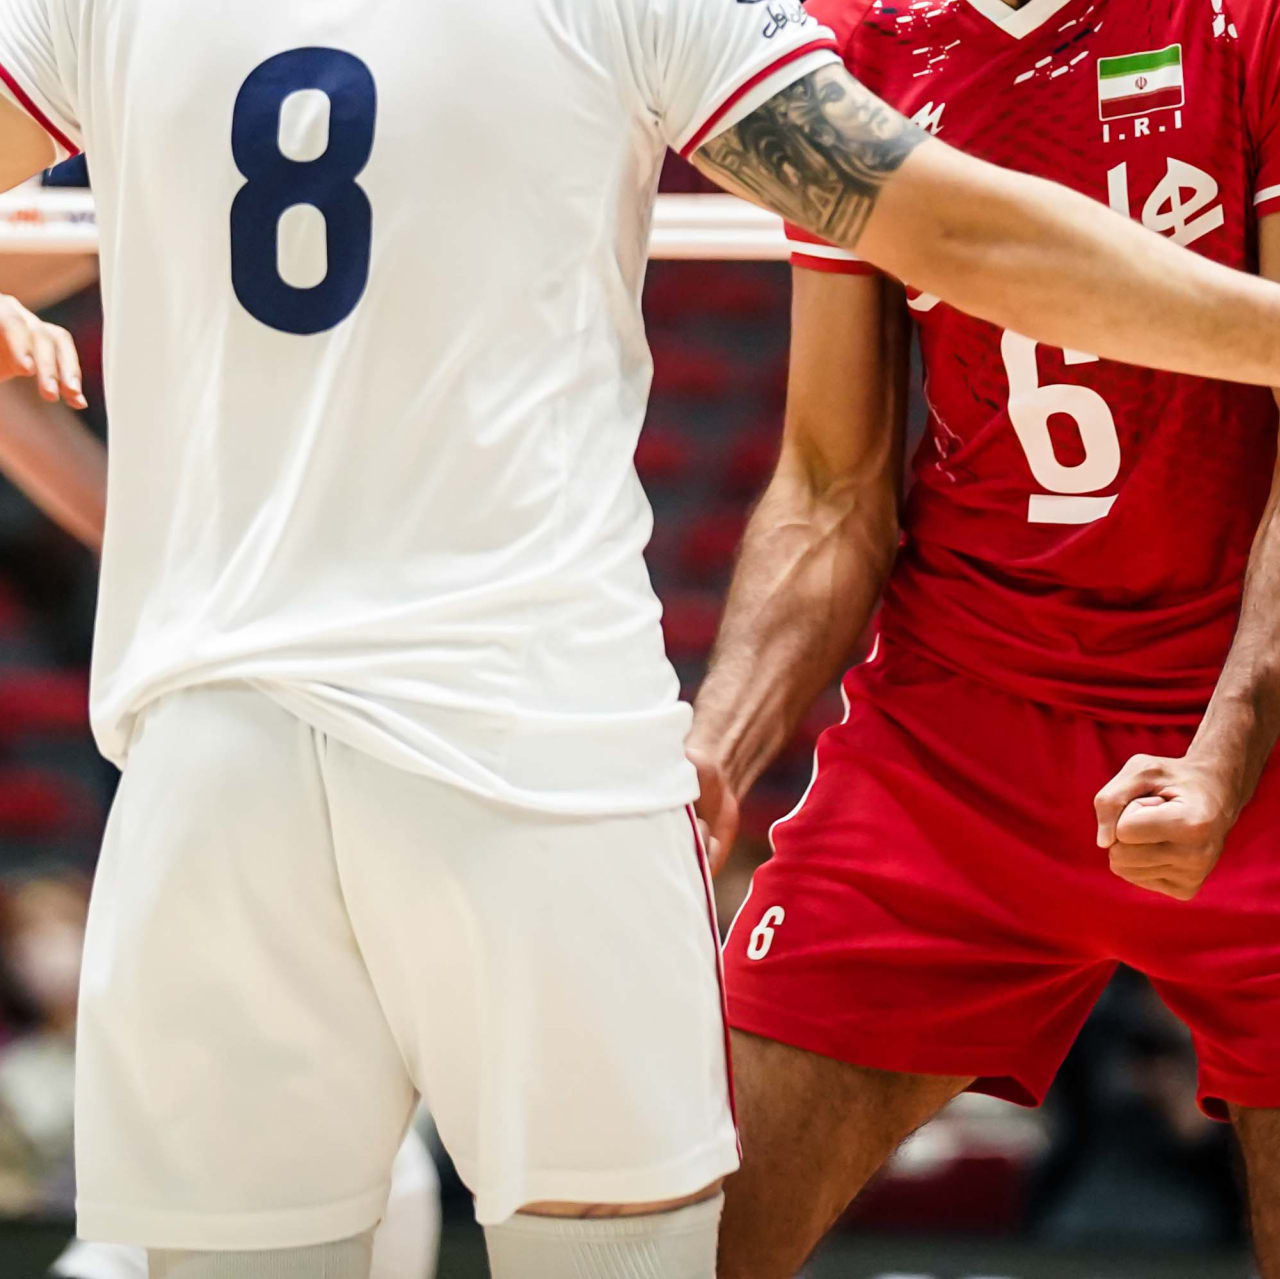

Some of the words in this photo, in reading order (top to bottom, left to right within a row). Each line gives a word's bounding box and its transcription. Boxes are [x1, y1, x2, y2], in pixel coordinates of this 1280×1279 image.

[230, 46, 377, 336] 8
[1000, 326, 1121, 494] 6
[746, 905, 786, 961] 6
